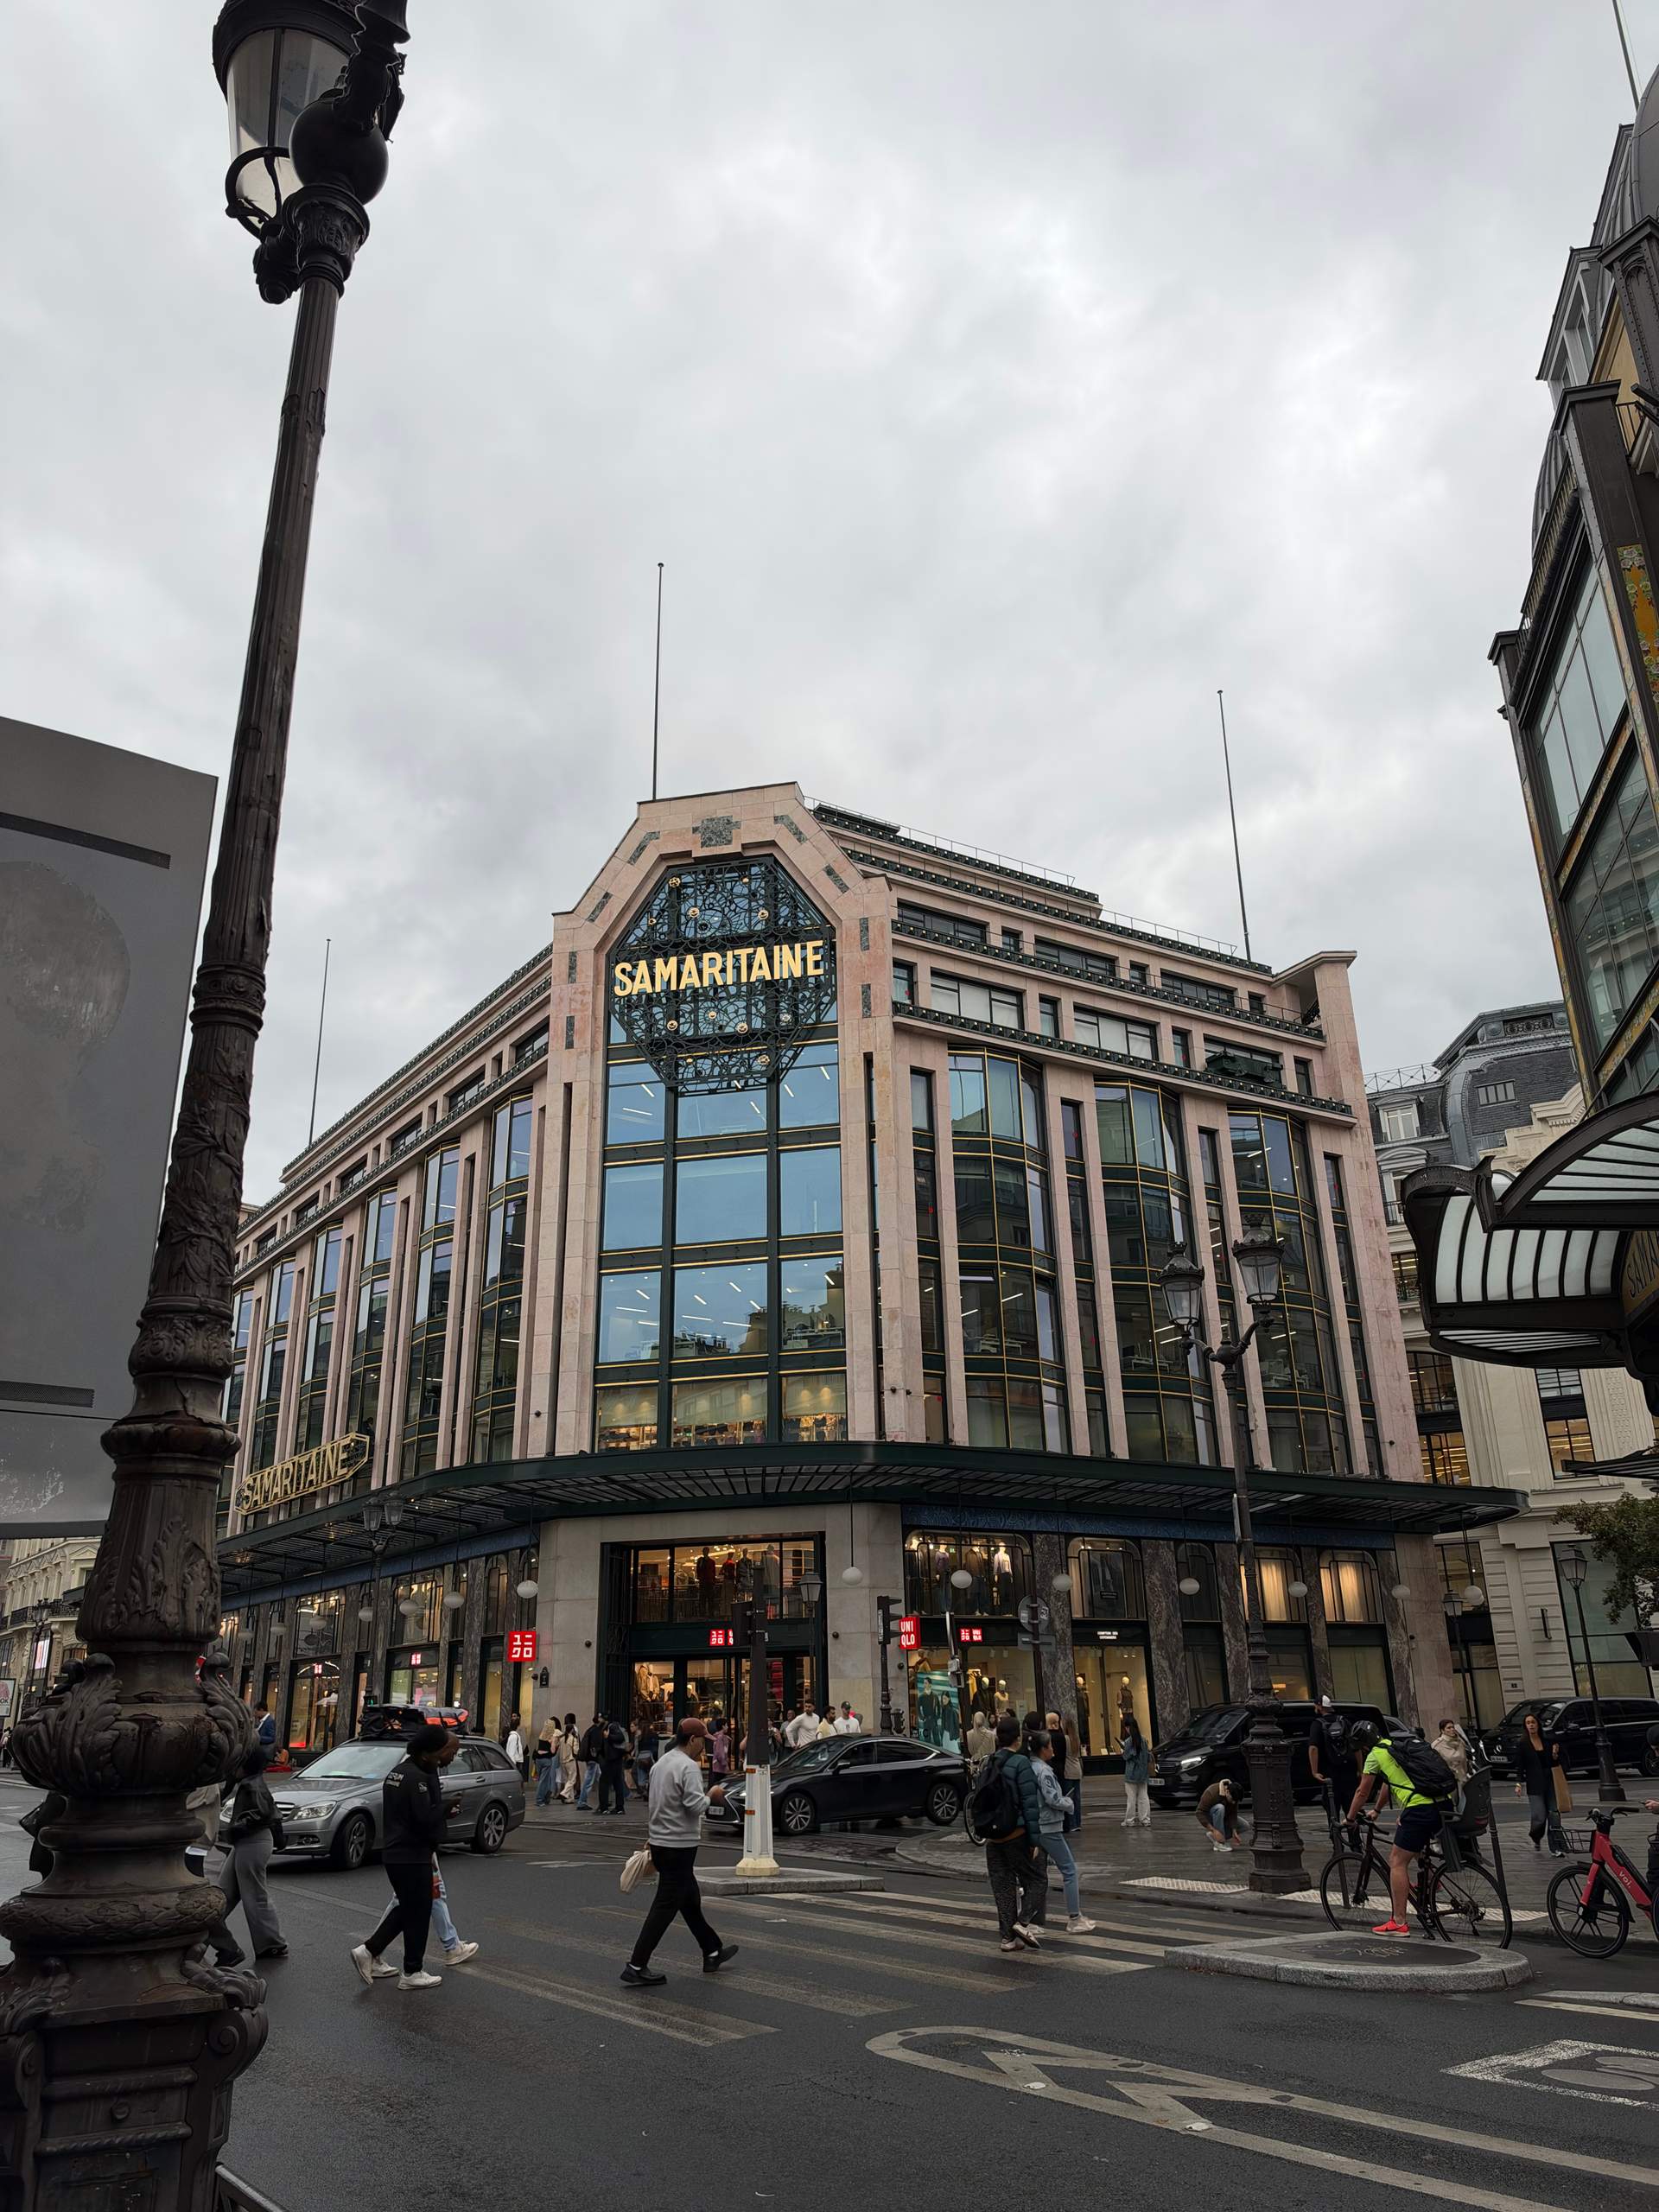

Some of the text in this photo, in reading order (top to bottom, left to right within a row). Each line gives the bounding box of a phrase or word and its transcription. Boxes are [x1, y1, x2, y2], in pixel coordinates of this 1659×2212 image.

[613, 940, 825, 997] SAMARITAINE
[242, 1440, 350, 1510] SAMARITAINE
[900, 1621, 914, 1632] UNI
[900, 1634, 915, 1648] QLO
